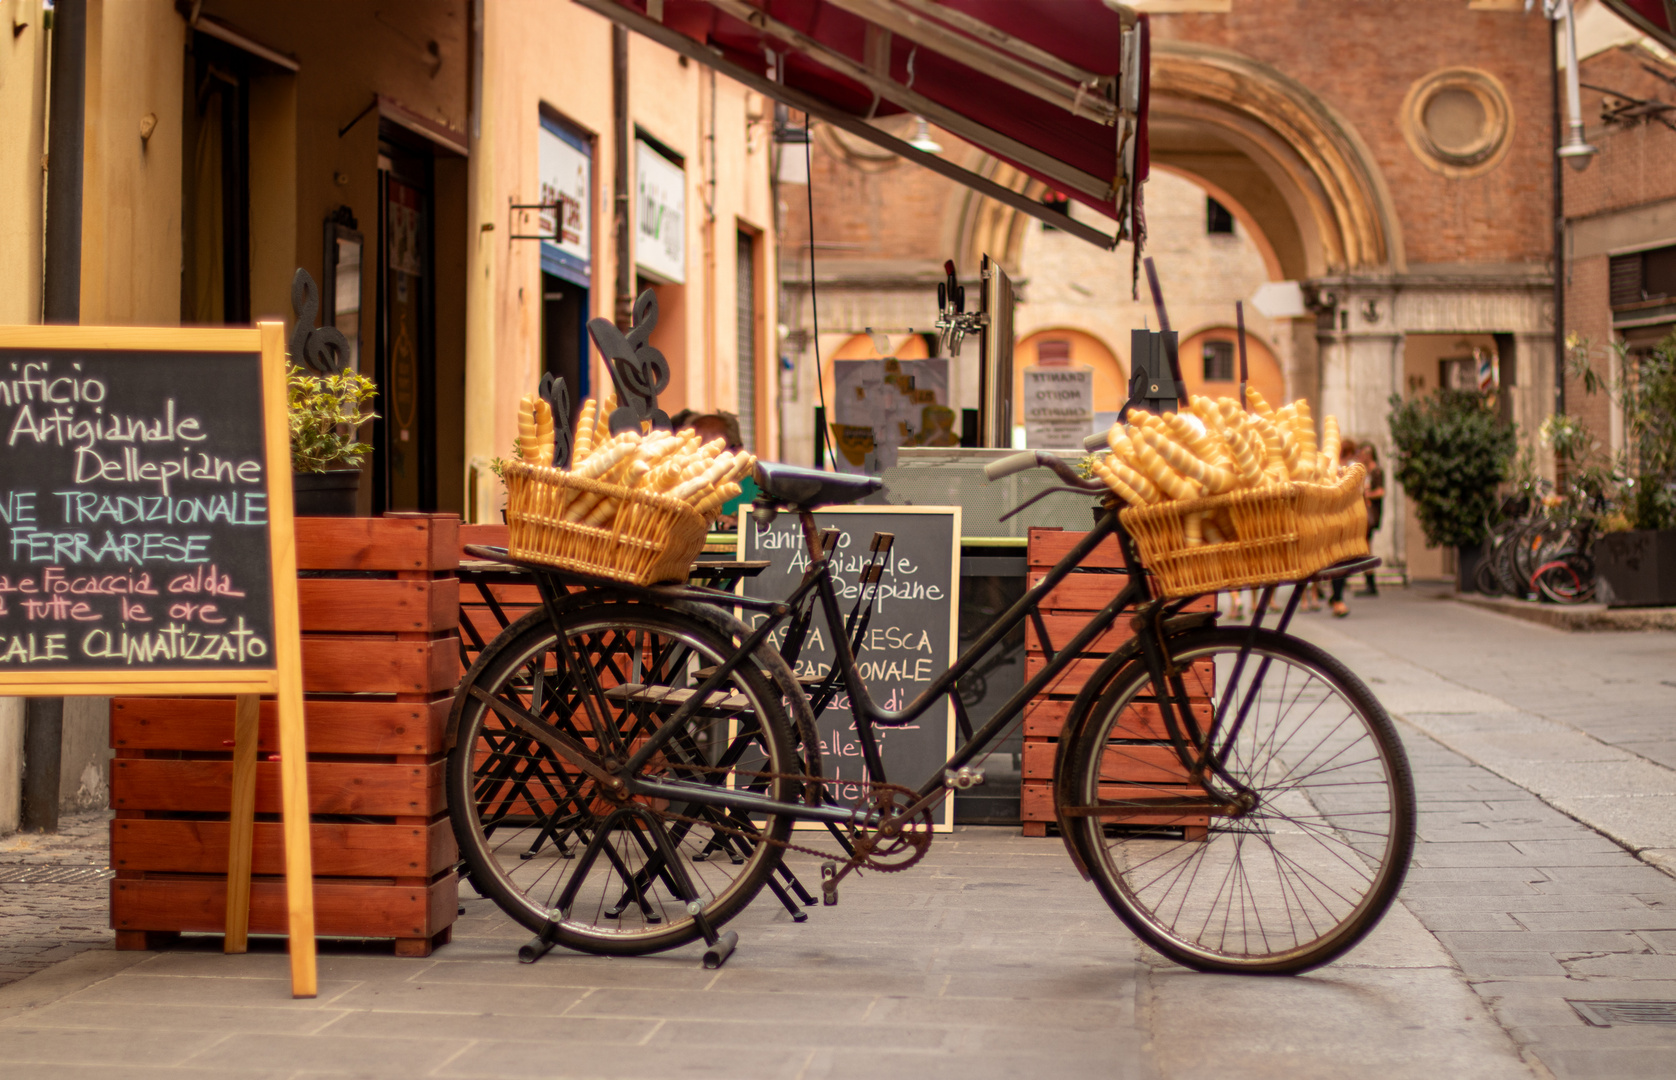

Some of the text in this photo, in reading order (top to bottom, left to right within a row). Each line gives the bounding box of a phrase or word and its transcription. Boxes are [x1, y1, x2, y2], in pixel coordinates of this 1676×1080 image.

[9, 398, 207, 450] Artigianale
[75, 446, 261, 497] Dellepiane
[52, 490, 268, 525] TRADIZIONALE
[10, 526, 211, 566] FERRARESE
[787, 546, 918, 582] Argianle
[44, 567, 159, 595] Focaccia
[168, 564, 246, 597] calda
[828, 574, 944, 613] Deepiane
[20, 594, 103, 621] tutte
[123, 597, 153, 622] le
[169, 602, 227, 623] ore
